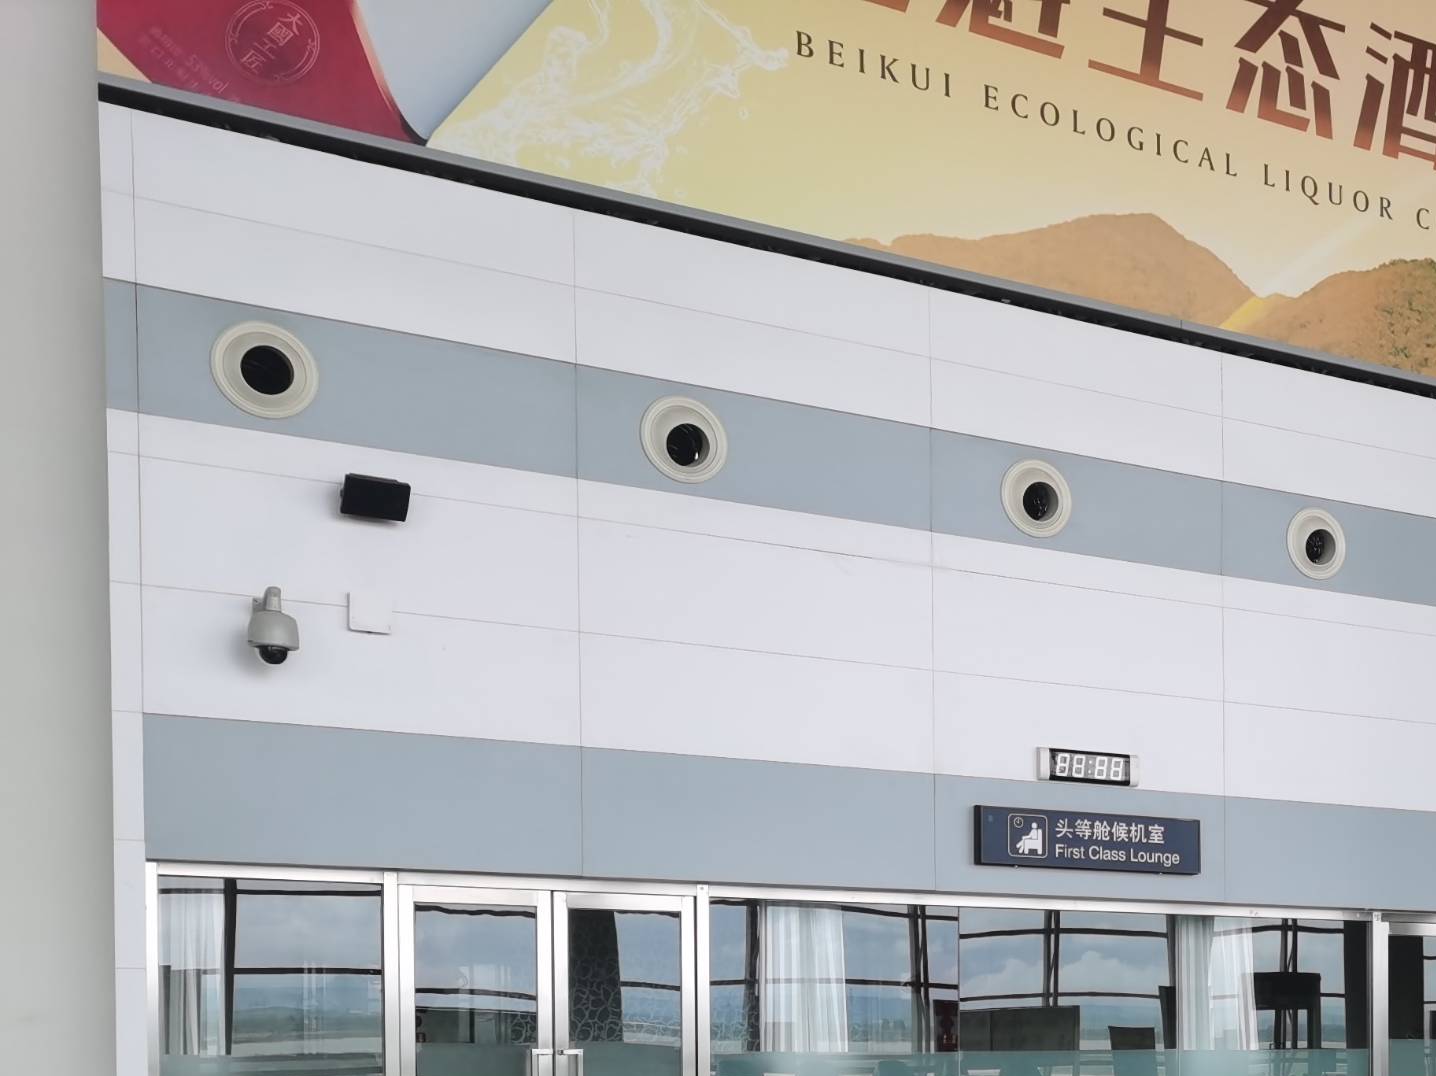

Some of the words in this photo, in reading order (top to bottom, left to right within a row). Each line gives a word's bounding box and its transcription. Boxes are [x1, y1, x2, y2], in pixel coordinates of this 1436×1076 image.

[796, 30, 951, 98] BEIKUI
[983, 84, 1238, 177] ECOLOGICAL
[1263, 163, 1393, 220] LIQUOR
[1055, 819, 1165, 844] 头等舱候机室
[1055, 843, 1085, 860] First
[1088, 845, 1126, 862] Class
[1130, 848, 1180, 867] Lounge
